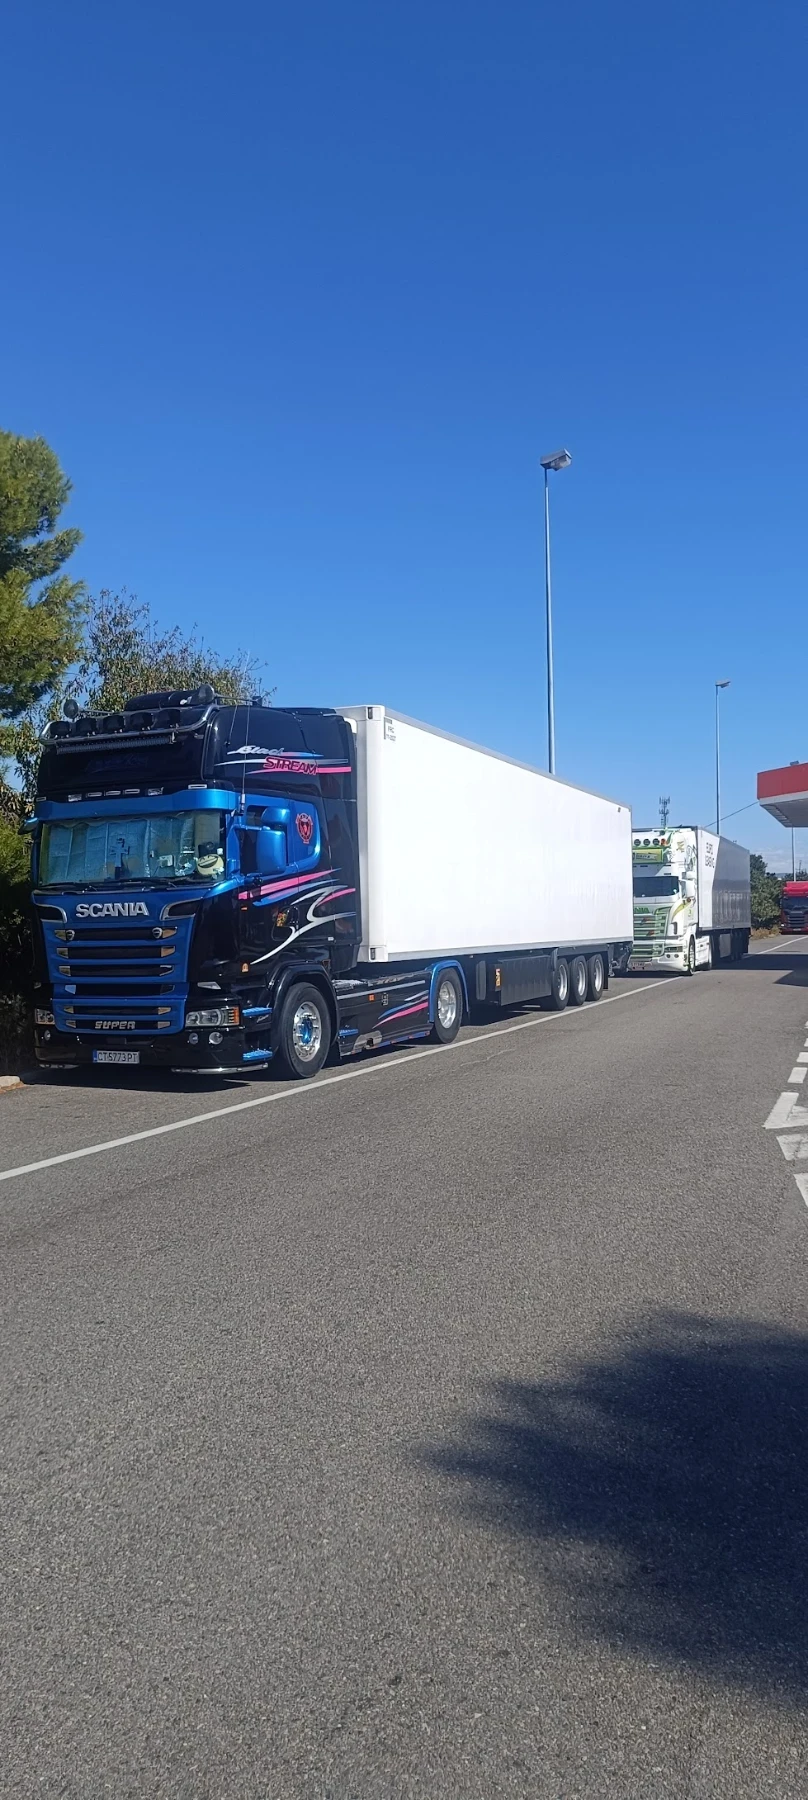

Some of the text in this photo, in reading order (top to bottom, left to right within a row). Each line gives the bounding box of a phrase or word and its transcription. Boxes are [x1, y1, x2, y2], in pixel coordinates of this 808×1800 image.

[263, 756, 317, 776] STREAM
[75, 901, 150, 918] SCANIA
[94, 1020, 136, 1030] SUPER
